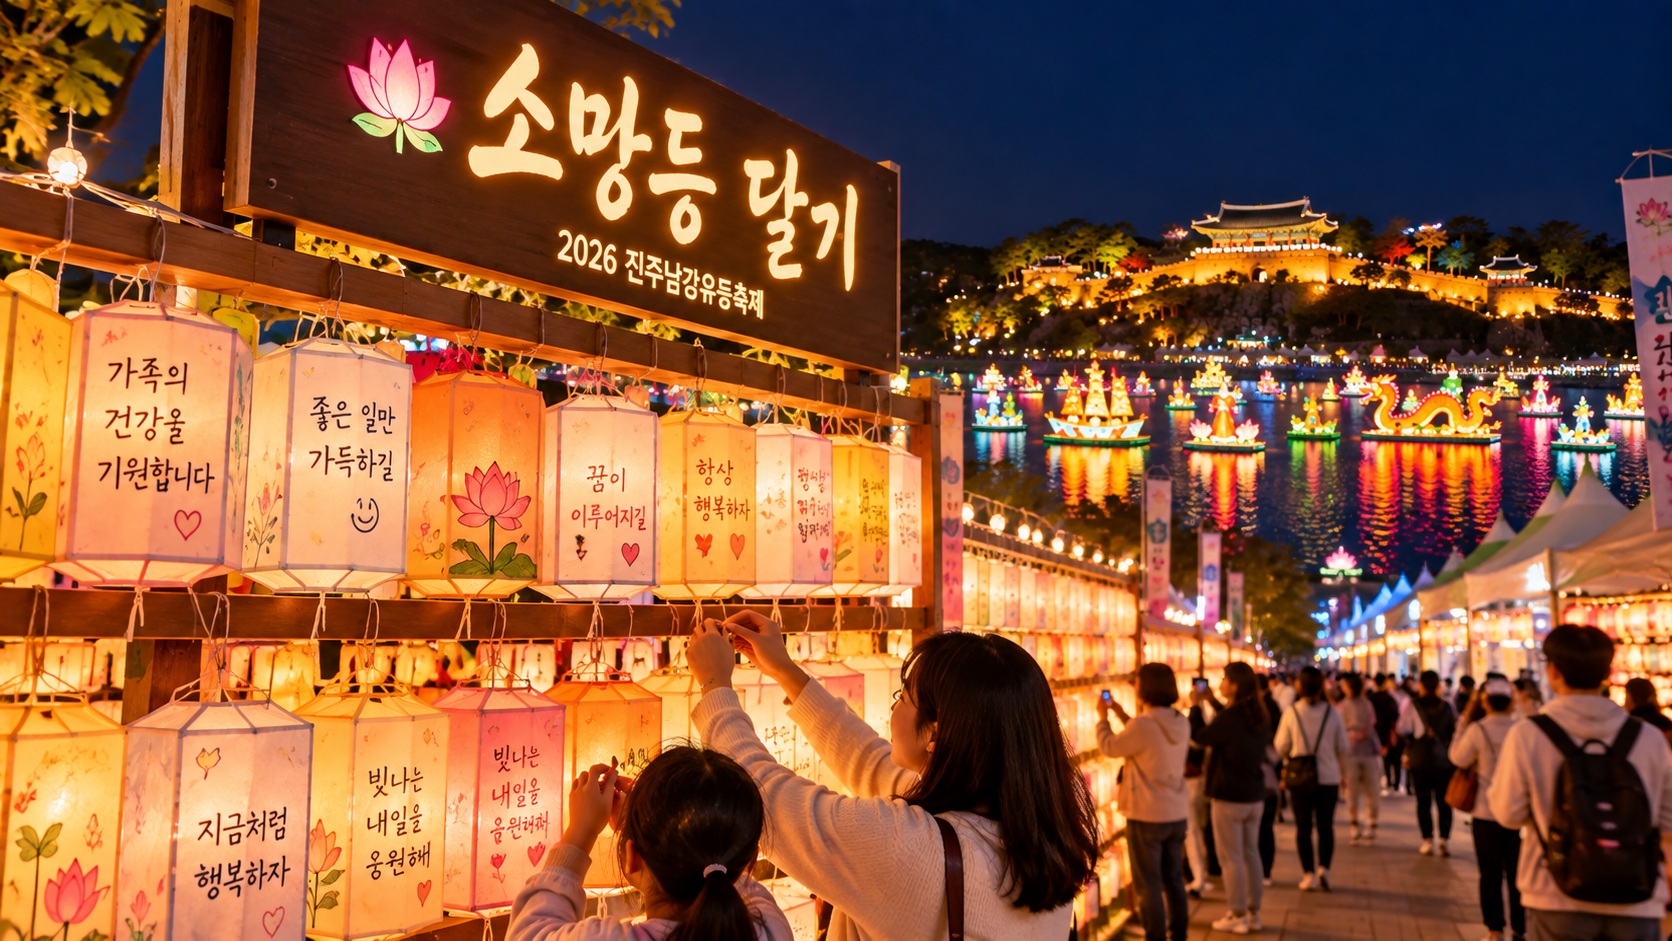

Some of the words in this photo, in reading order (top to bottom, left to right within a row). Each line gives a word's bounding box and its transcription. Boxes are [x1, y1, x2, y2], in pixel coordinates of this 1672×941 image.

[467, 43, 718, 245] 소망등
[743, 148, 859, 292] 달기
[557, 229, 618, 275] 2026
[624, 248, 765, 320] 진주남강유등축제
[107, 356, 189, 396] 가족의
[309, 396, 352, 432] 좋은
[361, 401, 396, 435] 일만
[97, 455, 216, 494] 기원합니다
[308, 444, 394, 482] 가득하길
[586, 464, 626, 494] 꿈이
[695, 457, 734, 486] 항상
[571, 503, 647, 531] 이루어지길
[197, 805, 287, 847] 지금처럼
[366, 803, 423, 837] 내일을
[193, 854, 292, 901] 행복하자
